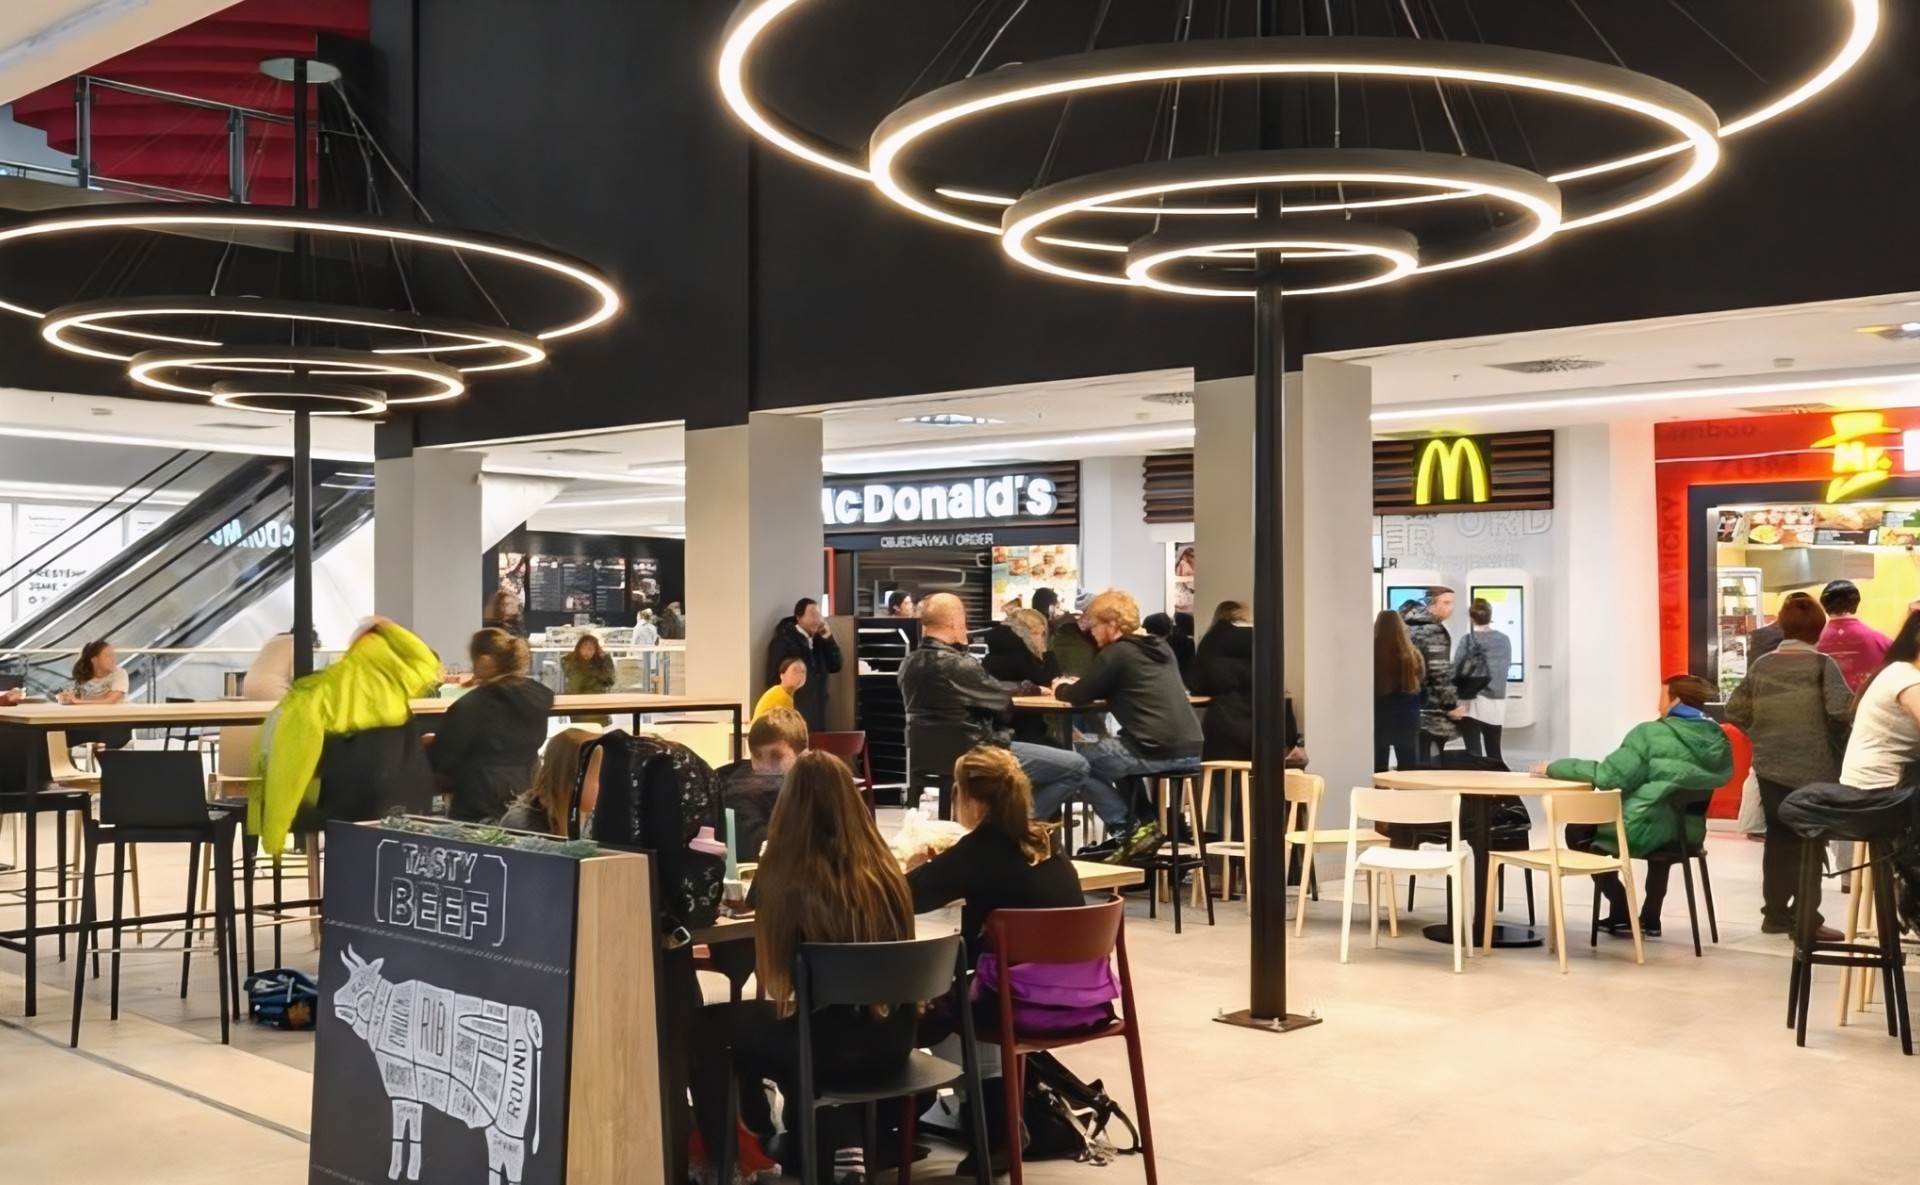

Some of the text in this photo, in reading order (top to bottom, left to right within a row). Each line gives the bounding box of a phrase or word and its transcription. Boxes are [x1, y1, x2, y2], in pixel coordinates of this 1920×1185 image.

[956, 532, 994, 546] ORDER
[402, 843, 478, 884] TASTY
[389, 876, 489, 940] BEEF
[421, 997, 446, 1057] RIB
[506, 1038, 528, 1120] ROUND
